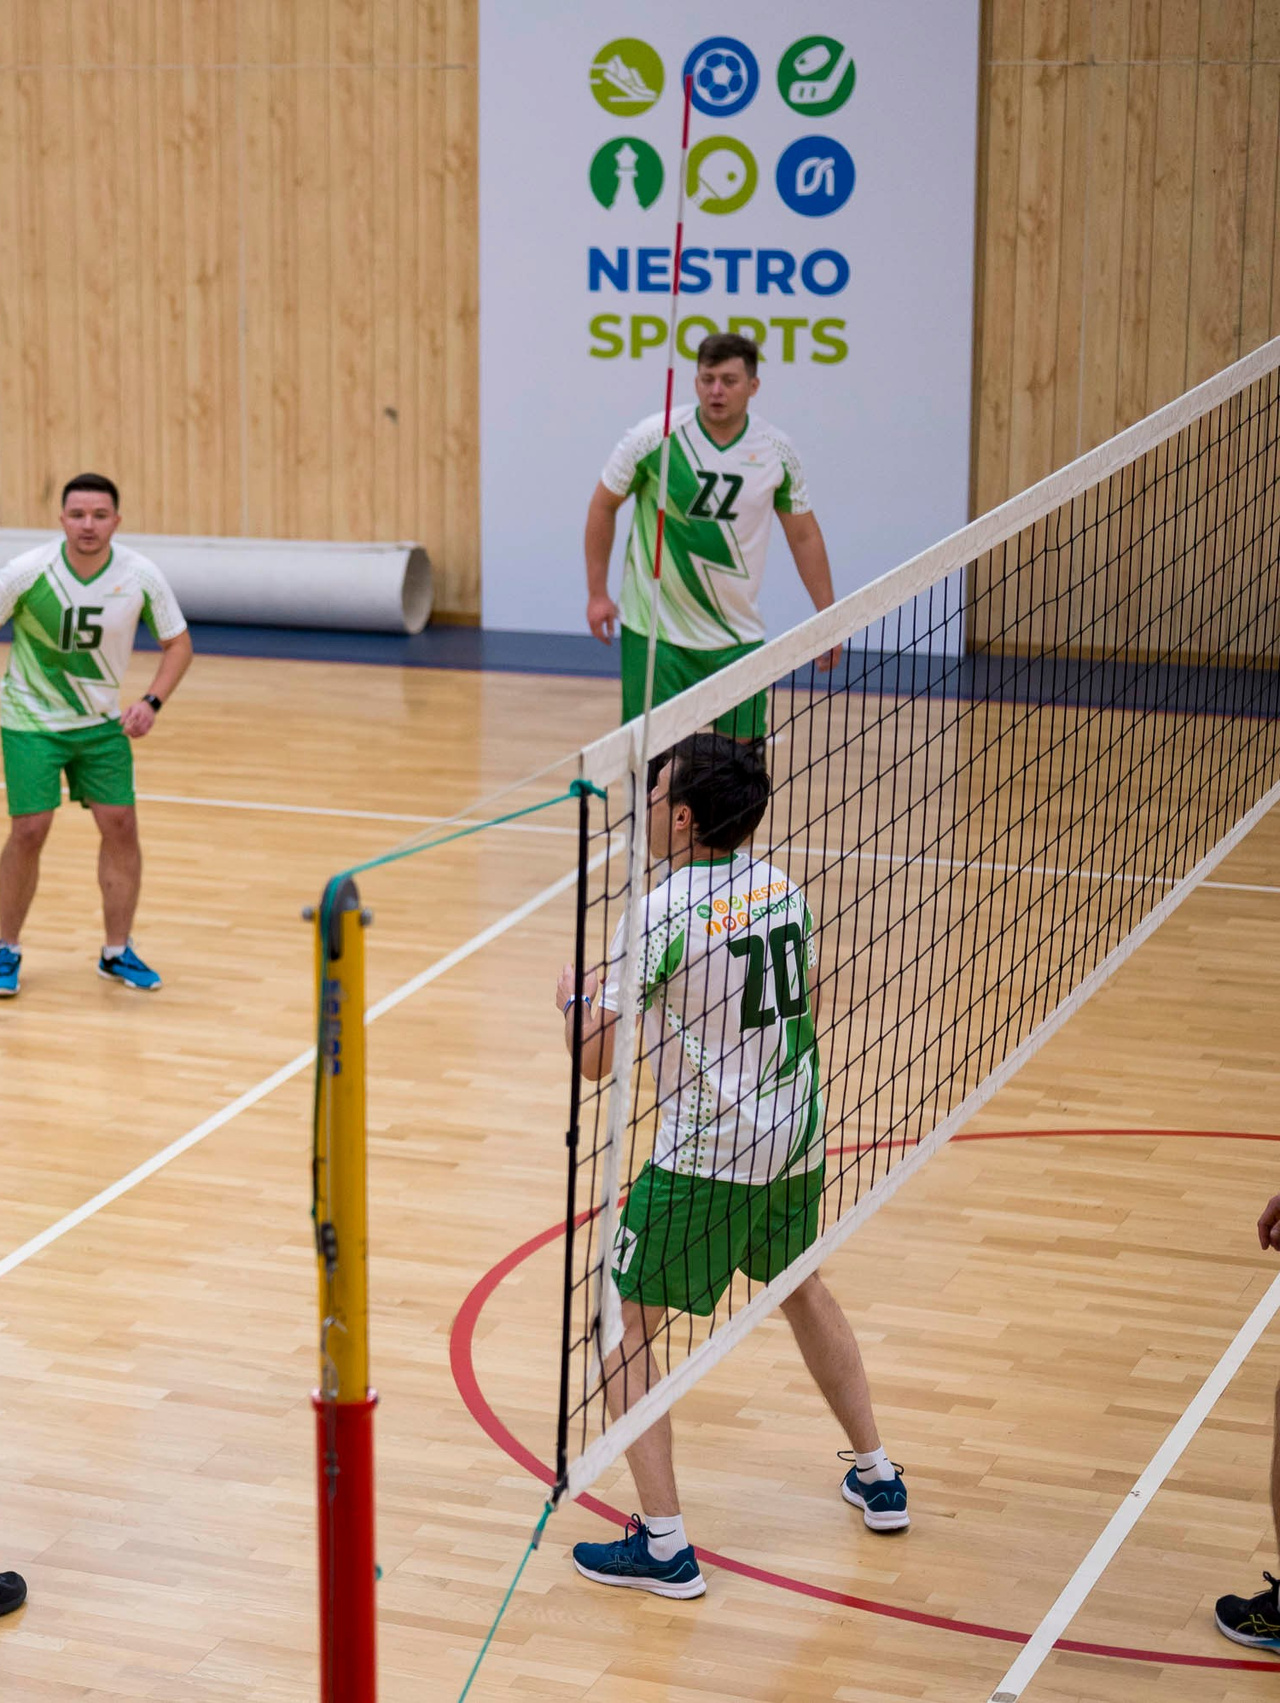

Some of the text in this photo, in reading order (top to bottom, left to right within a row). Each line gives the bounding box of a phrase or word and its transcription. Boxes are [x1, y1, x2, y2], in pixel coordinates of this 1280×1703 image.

[587, 246, 850, 296] NESTRO
[688, 470, 744, 521] 22
[61, 606, 104, 650] 15
[725, 921, 809, 1031] 20
